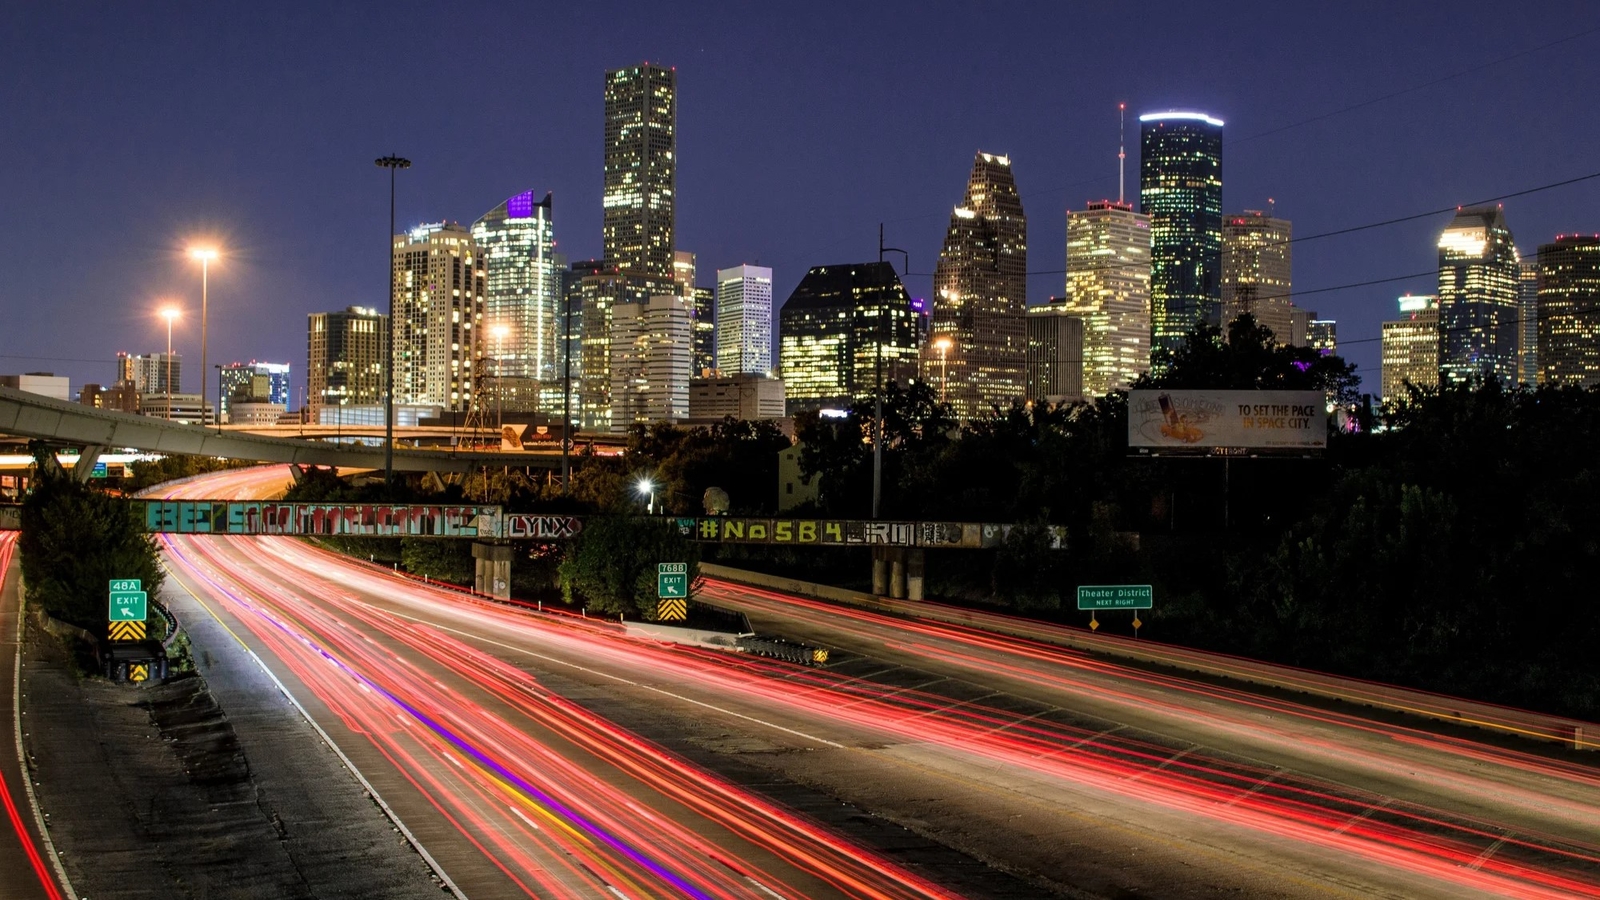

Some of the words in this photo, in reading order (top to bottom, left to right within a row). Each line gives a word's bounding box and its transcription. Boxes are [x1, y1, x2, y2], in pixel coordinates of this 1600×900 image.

[1238, 404, 1251, 416] TO
[1253, 404, 1270, 416] SET
[1271, 405, 1289, 416] THE
[1291, 405, 1315, 417] PACE
[1243, 417, 1255, 428] IN
[1257, 417, 1286, 429] SPACE
[1288, 417, 1311, 429] CITY.
[508, 515, 575, 538] LYNX
[662, 564, 684, 572] 768B
[113, 581, 137, 590] 48A
[1118, 588, 1150, 597] District
